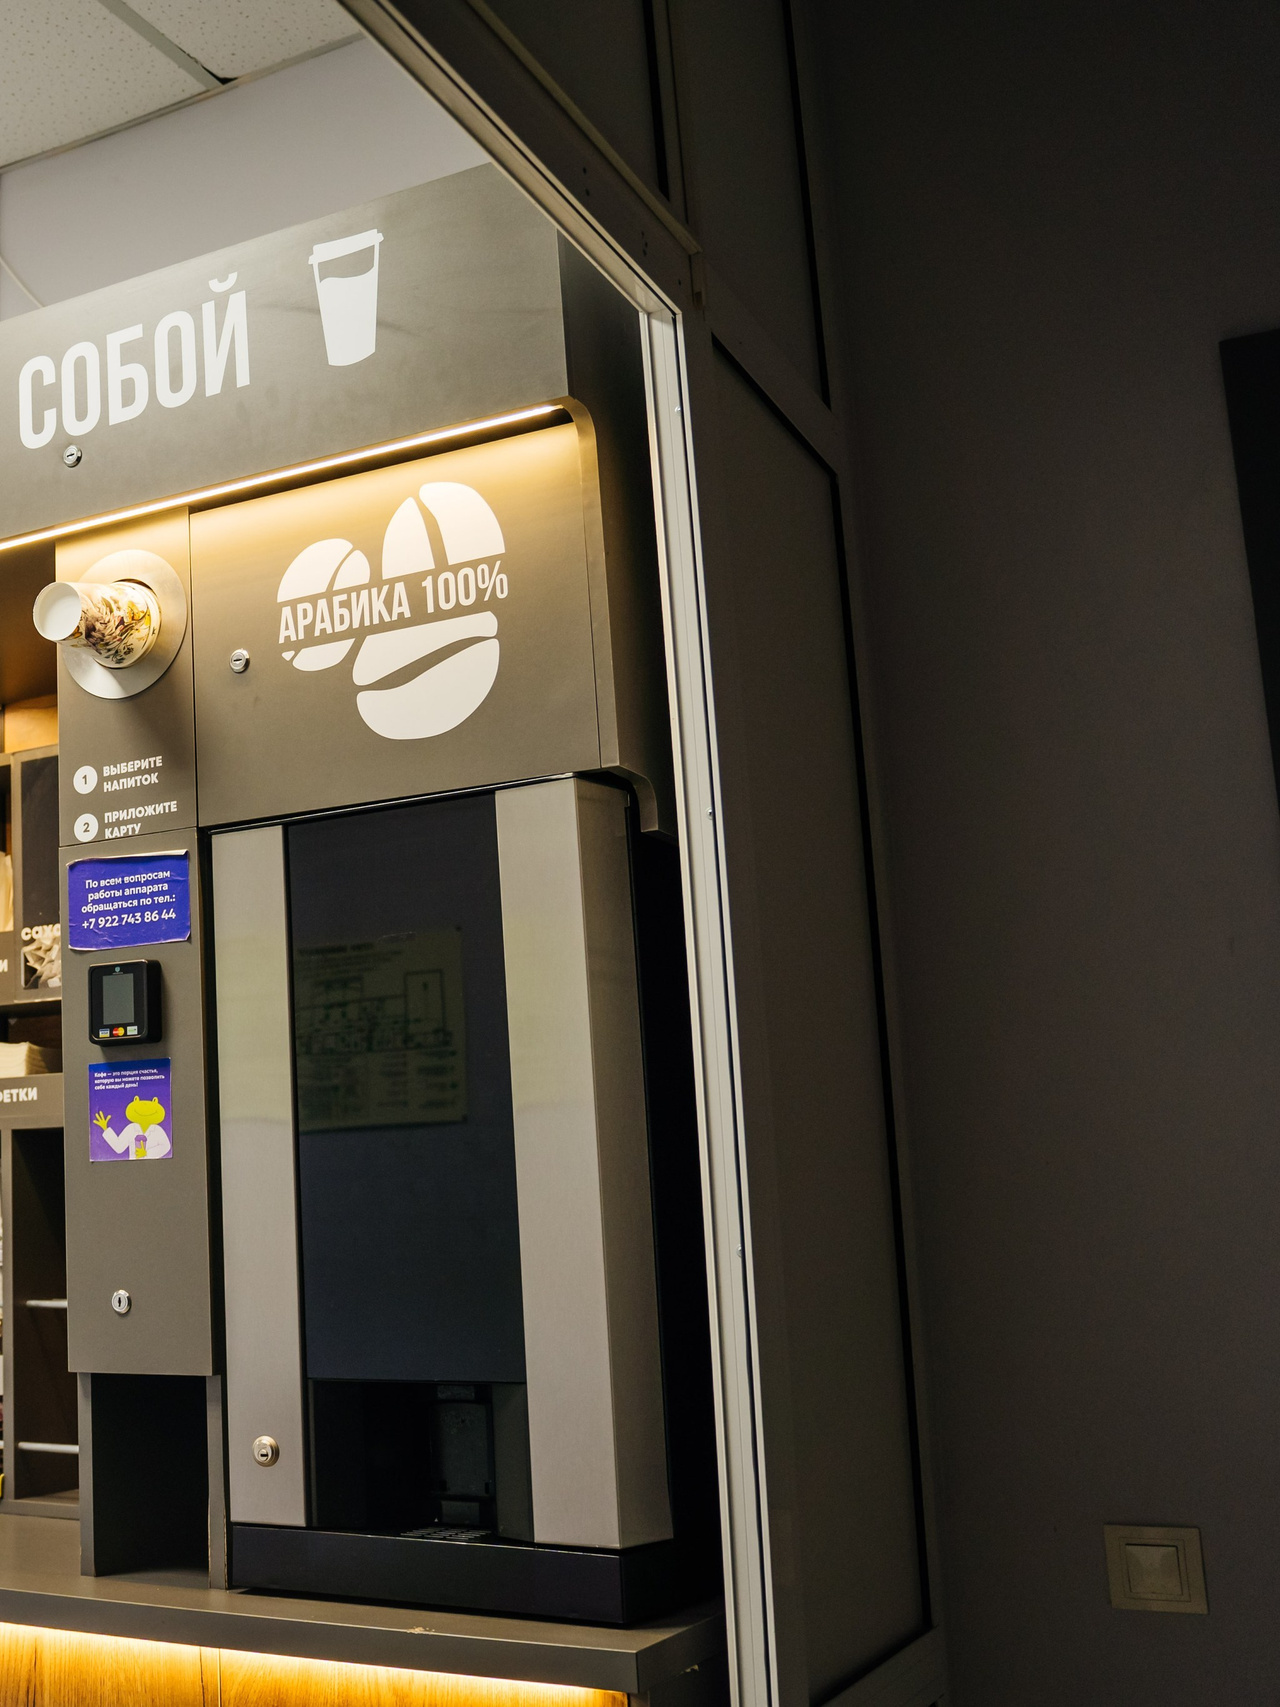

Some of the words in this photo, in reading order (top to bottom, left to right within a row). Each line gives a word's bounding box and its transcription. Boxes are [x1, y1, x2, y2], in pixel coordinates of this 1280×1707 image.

[19, 271, 251, 449] СОБОЙ
[278, 581, 412, 644] АРАБИКА
[421, 560, 509, 614] 100%
[102, 755, 163, 777] ВЫБЕРИТЕ
[82, 774, 88, 785] 1
[103, 772, 159, 793] НАПИТОК
[104, 800, 178, 823] ПРИЛОЖИТЕ
[83, 822, 90, 833] 2
[104, 823, 142, 839] КАРТУ
[85, 879, 99, 889] По
[100, 876, 122, 887] всем
[123, 870, 171, 884] вопросам
[87, 889, 123, 902] работы
[124, 882, 169, 895] аппарата
[81, 898, 138, 914] обращаться
[140, 898, 152, 906] по
[153, 894, 176, 904] тел.:
[82, 918, 96, 930] +7
[98, 915, 119, 928] 922
[121, 912, 142, 925] 743
[144, 910, 159, 923] 86
[161, 908, 176, 920] 44
